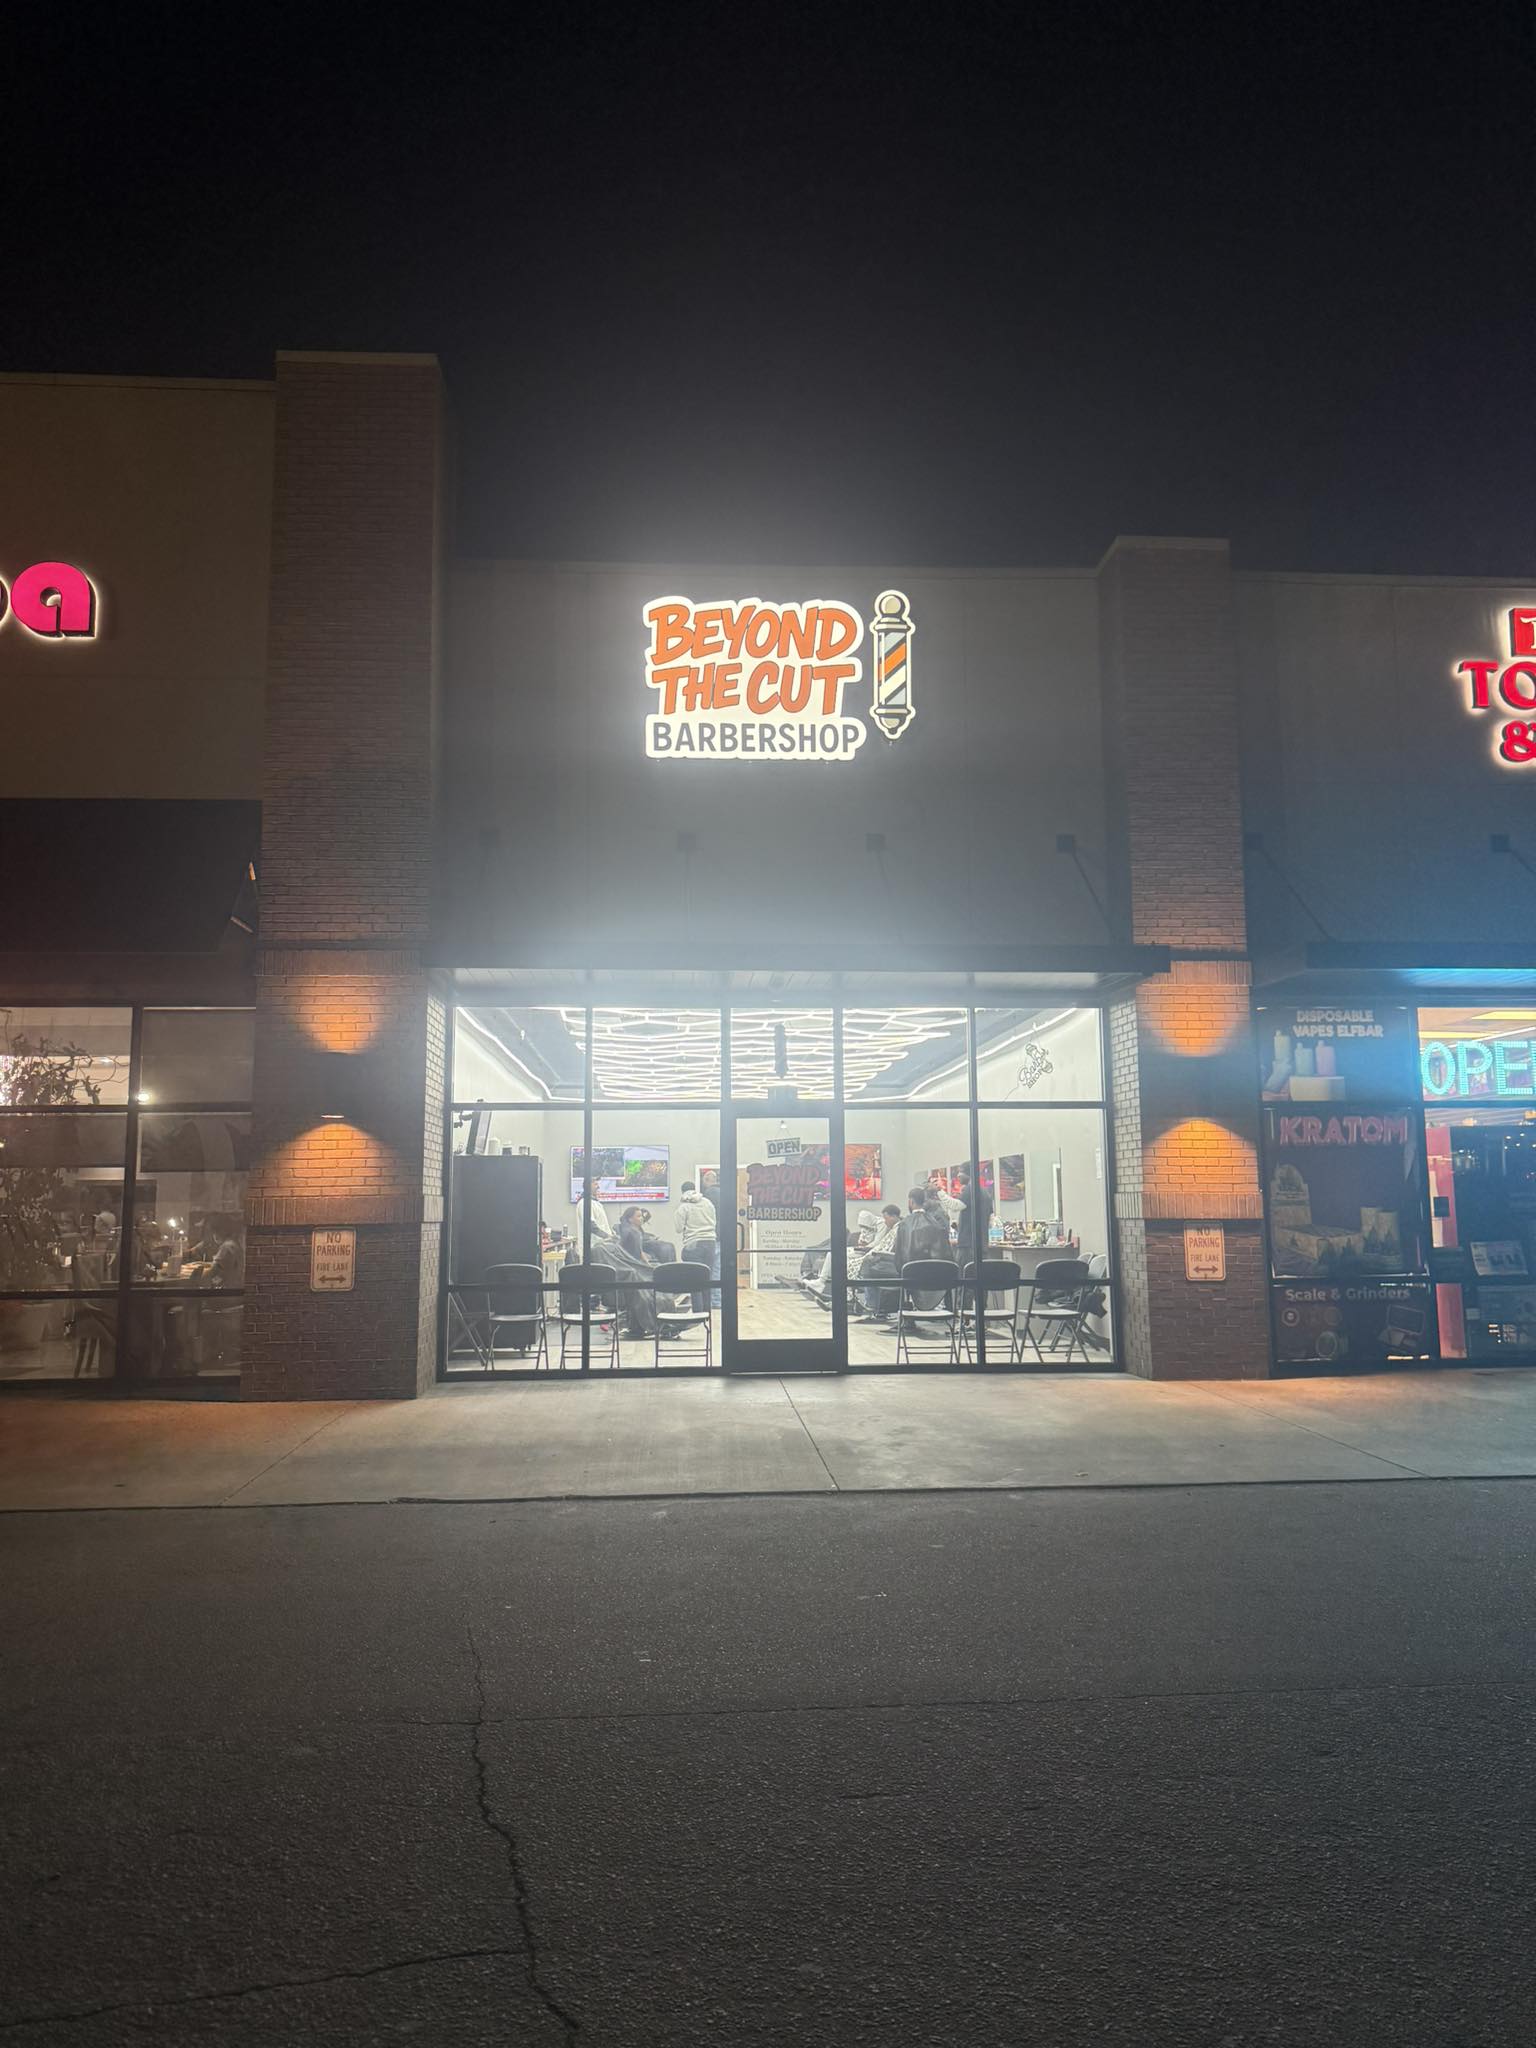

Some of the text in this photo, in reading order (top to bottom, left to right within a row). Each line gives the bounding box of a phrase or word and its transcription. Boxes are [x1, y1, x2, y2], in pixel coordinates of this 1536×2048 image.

[648, 603, 857, 666] BEYOND
[652, 661, 856, 716] THE CUT
[653, 722, 860, 753] BARBERSHOP
[1296, 1009, 1374, 1023] DISPOSABLE
[1293, 1024, 1385, 1038] VAPES ELFBAR
[1420, 1040, 1536, 1096] OPE
[1280, 1115, 1408, 1145] KRATOM
[767, 1139, 801, 1155] OPEN
[751, 1164, 819, 1185] BEYOND
[751, 1185, 817, 1205] THE CUT
[749, 1207, 820, 1220] BARBERSHOP
[326, 1231, 342, 1244] NO
[1197, 1226, 1210, 1236] NO
[1189, 1237, 1220, 1248] PARKING
[316, 1244, 351, 1257] PARKING
[1285, 1287, 1411, 1302] Scale & Grinders
